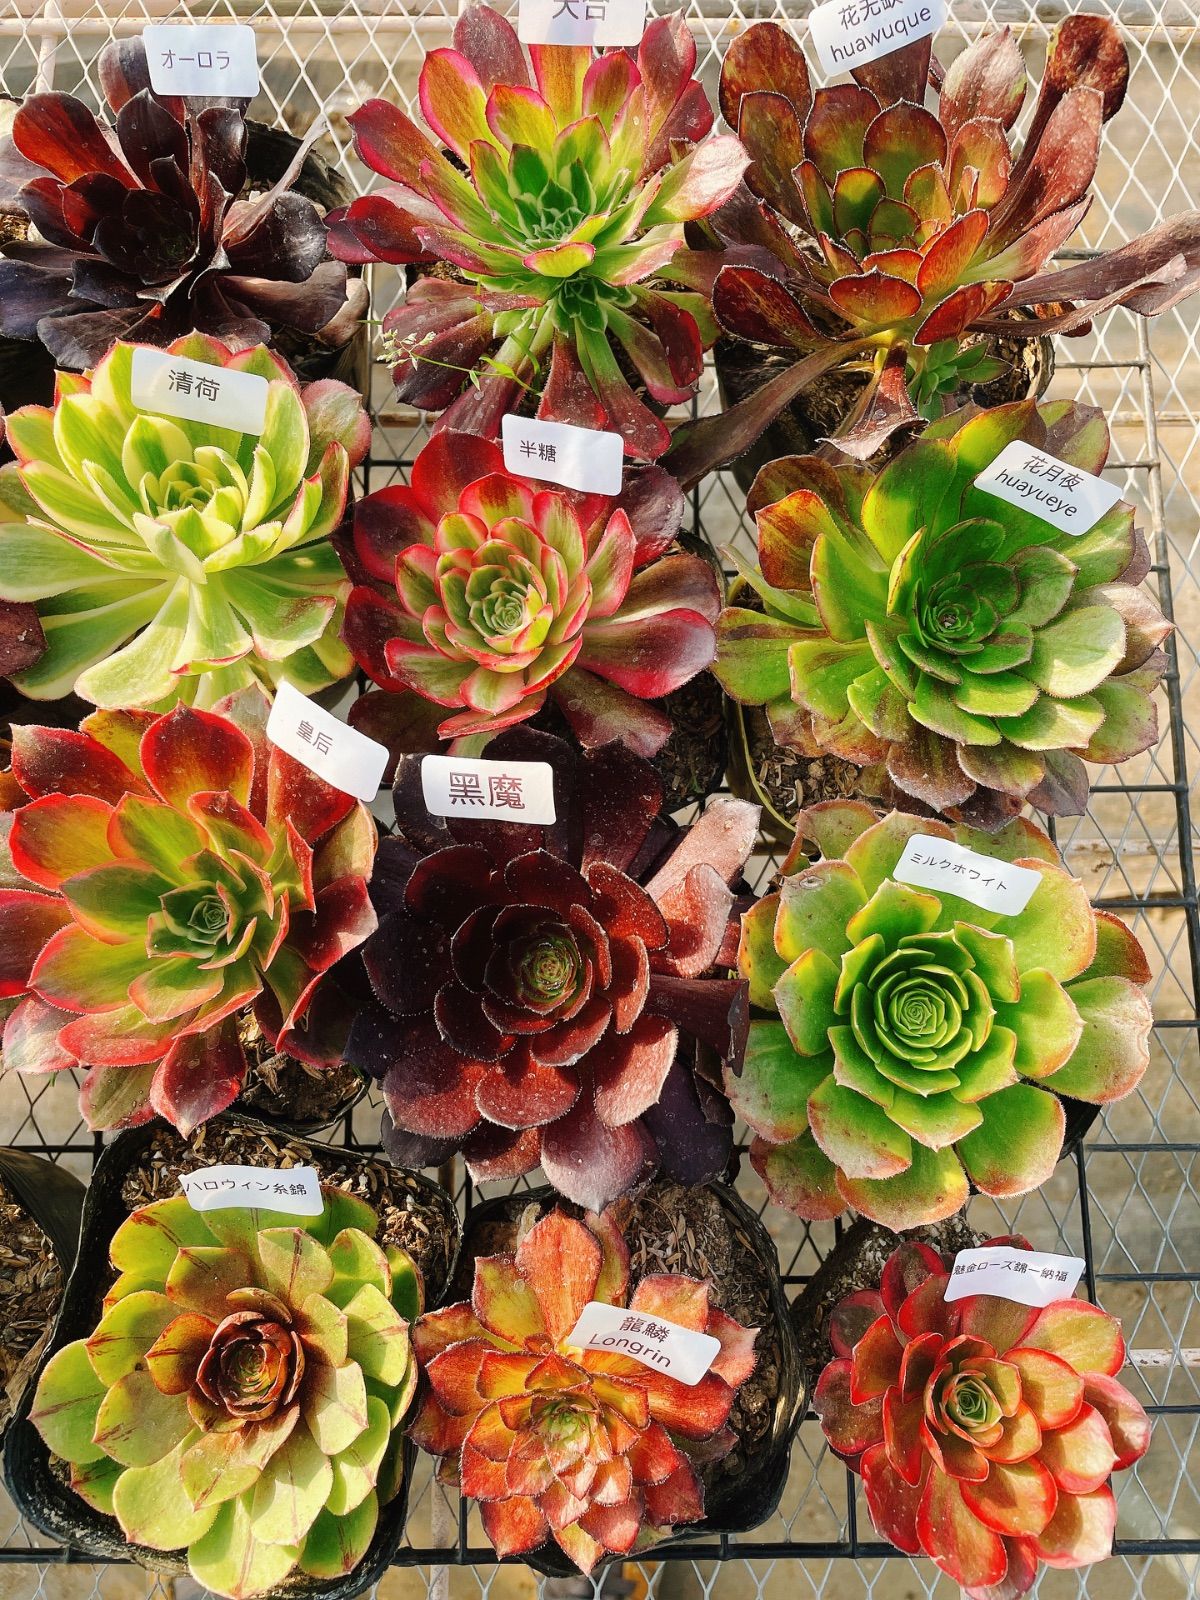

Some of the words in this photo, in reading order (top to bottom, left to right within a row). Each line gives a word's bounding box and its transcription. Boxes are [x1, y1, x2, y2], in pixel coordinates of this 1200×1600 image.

[830, 7, 931, 63] huawuque
[161, 50, 230, 69] オーロラ
[168, 370, 220, 401] 清荷
[520, 440, 557, 462] 半糖
[1022, 455, 1084, 492] 花月夜
[995, 469, 1077, 517] huayueye
[295, 720, 333, 755] 皇后
[449, 772, 525, 810] 黑魔
[910, 853, 1007, 890] ミルクホワイト
[619, 1316, 670, 1343] 龍鱗
[589, 1334, 670, 1368] Longrin
